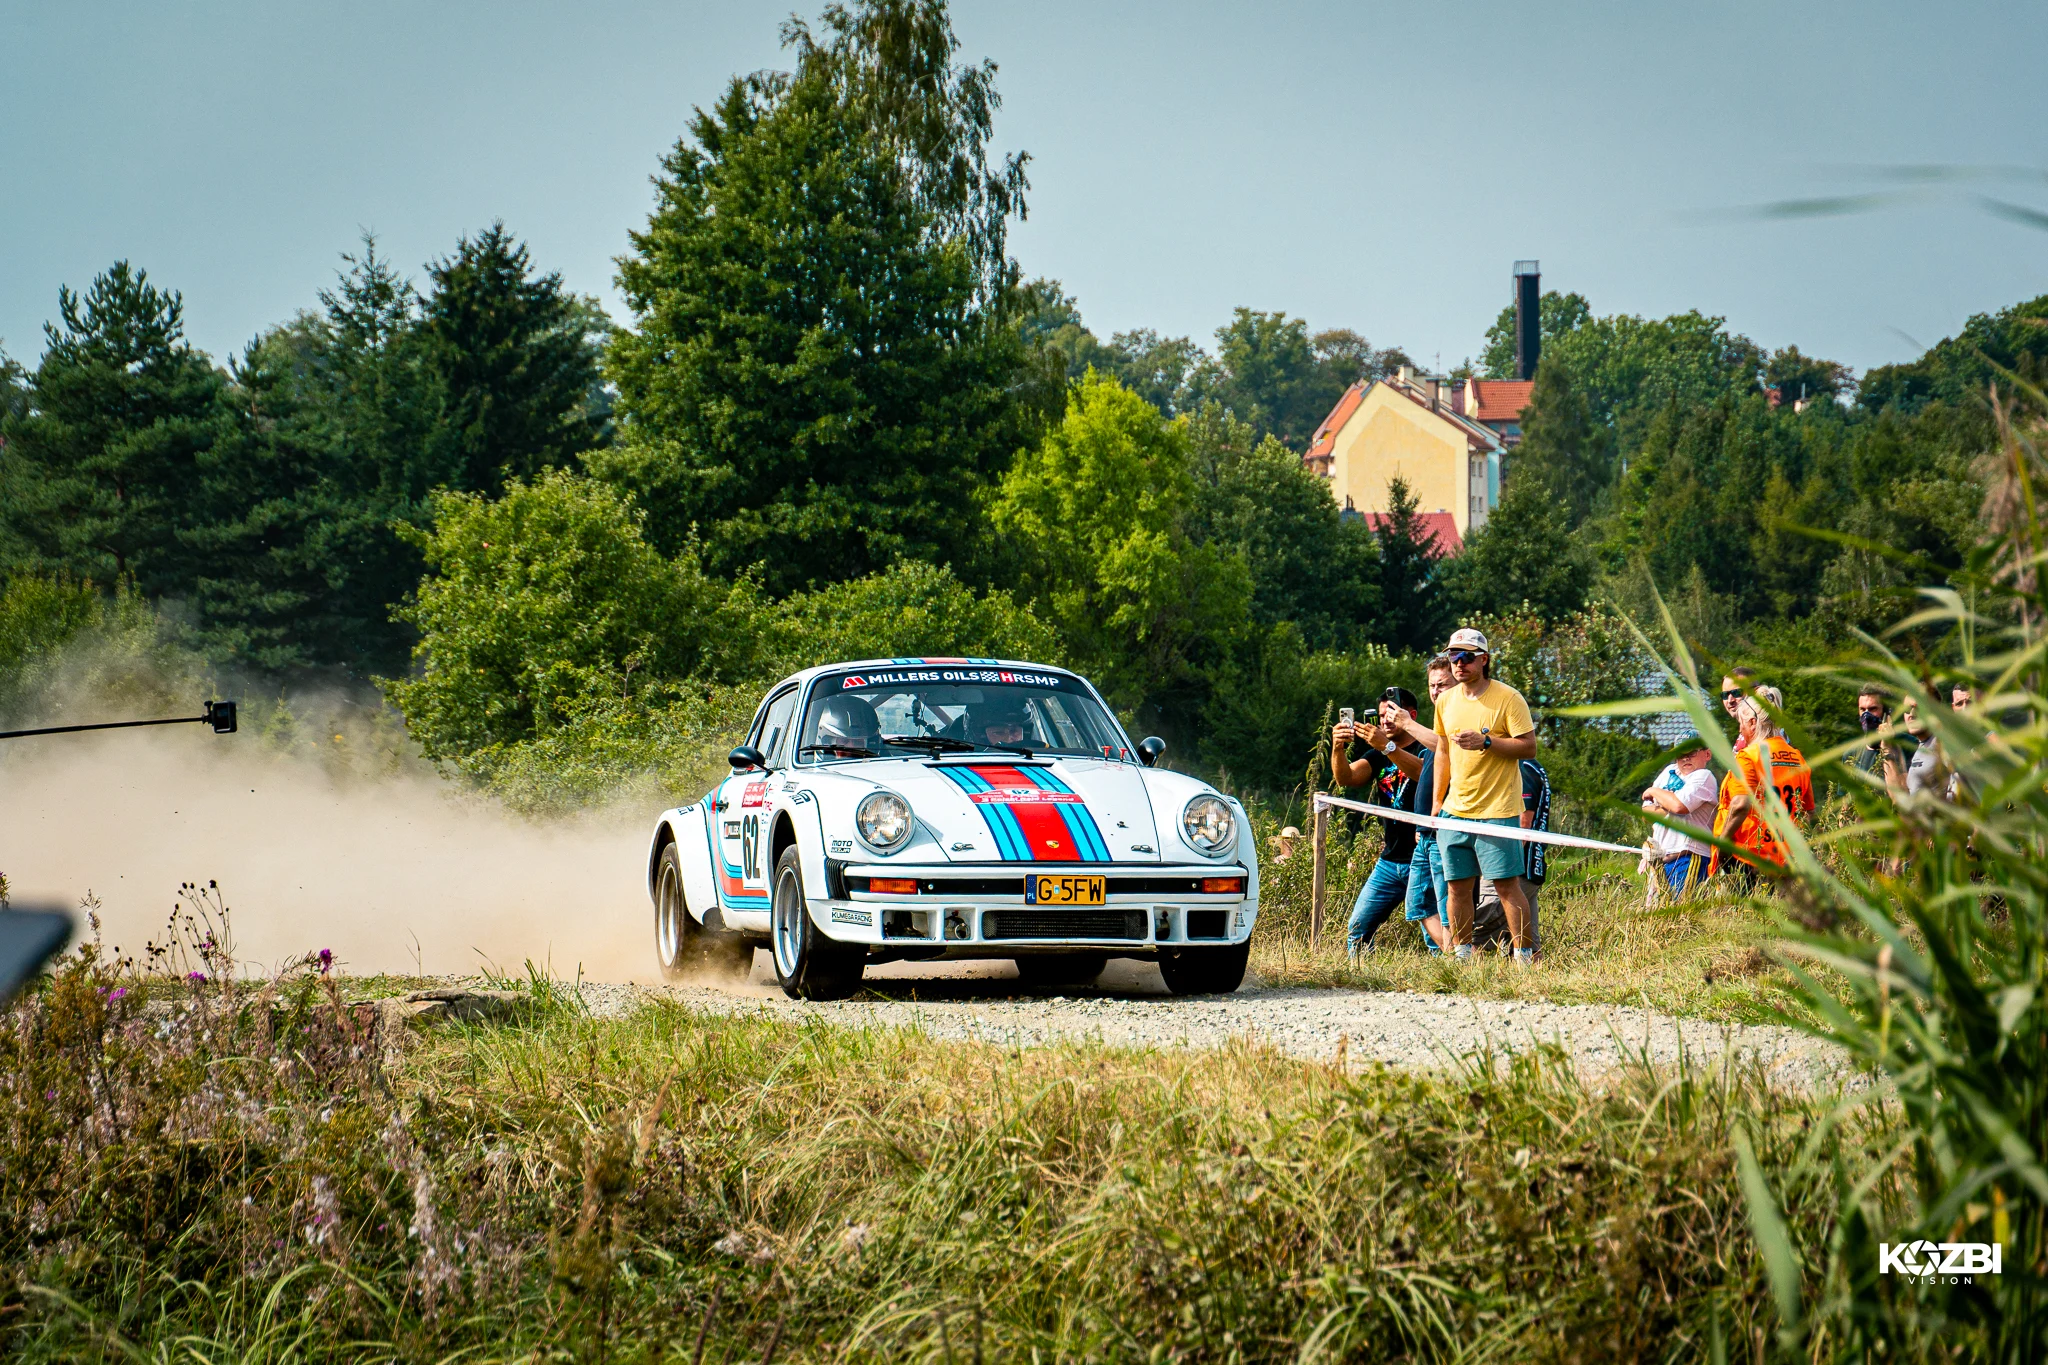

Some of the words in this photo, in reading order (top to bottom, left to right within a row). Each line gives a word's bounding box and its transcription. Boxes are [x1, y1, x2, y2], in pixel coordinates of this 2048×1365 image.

[868, 671, 940, 684] MILLERS
[943, 671, 980, 681] OILS
[1000, 672, 1059, 687] HRSMP
[742, 814, 760, 880] 62
[1027, 892, 1036, 900] PL
